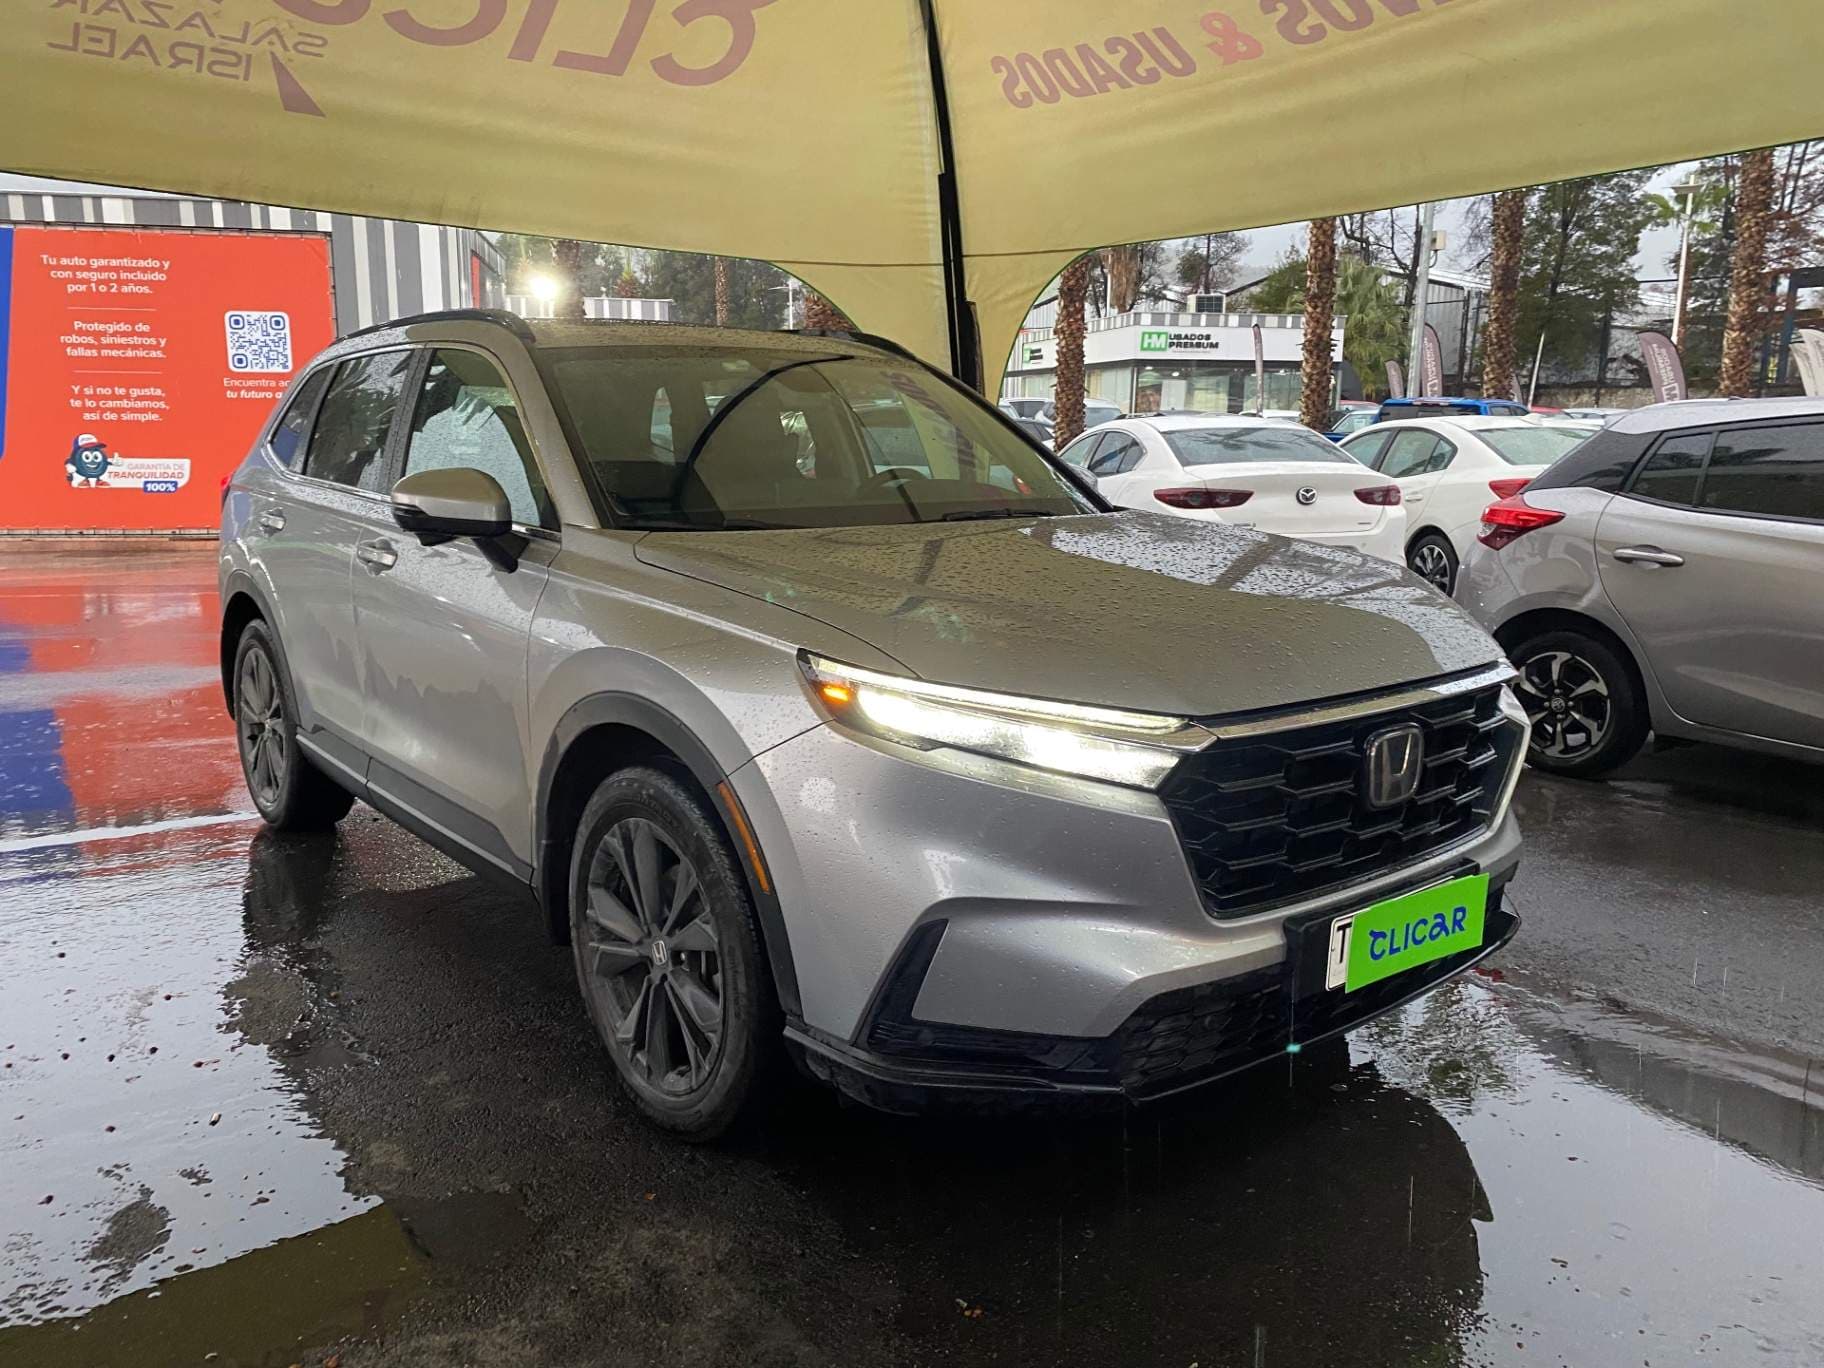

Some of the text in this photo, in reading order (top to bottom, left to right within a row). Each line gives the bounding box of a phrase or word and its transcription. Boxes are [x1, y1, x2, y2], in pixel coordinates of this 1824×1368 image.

[41, 254, 170, 270] Tu auto garantizado y
[50, 270, 167, 281] con seguro incluido
[67, 283, 153, 294] por 1 o 2 años.
[74, 321, 151, 333] Protegido de
[60, 335, 167, 347] robos, siniestros y
[1142, 333, 1167, 349] HM
[1169, 333, 1211, 341] USADOS
[66, 346, 167, 358] fallas mecánicas.
[223, 378, 276, 387] Encuentra
[71, 385, 165, 398] Y si no te gusta,
[226, 391, 238, 399] tu
[240, 389, 273, 399] futuro
[69, 398, 170, 410] te lo cambiamos,
[102, 411, 119, 420] de
[120, 411, 163, 423] simple.
[172, 463, 185, 471] DE
[107, 471, 184, 479] TRANQUILIDAD
[145, 482, 176, 492] 100%
